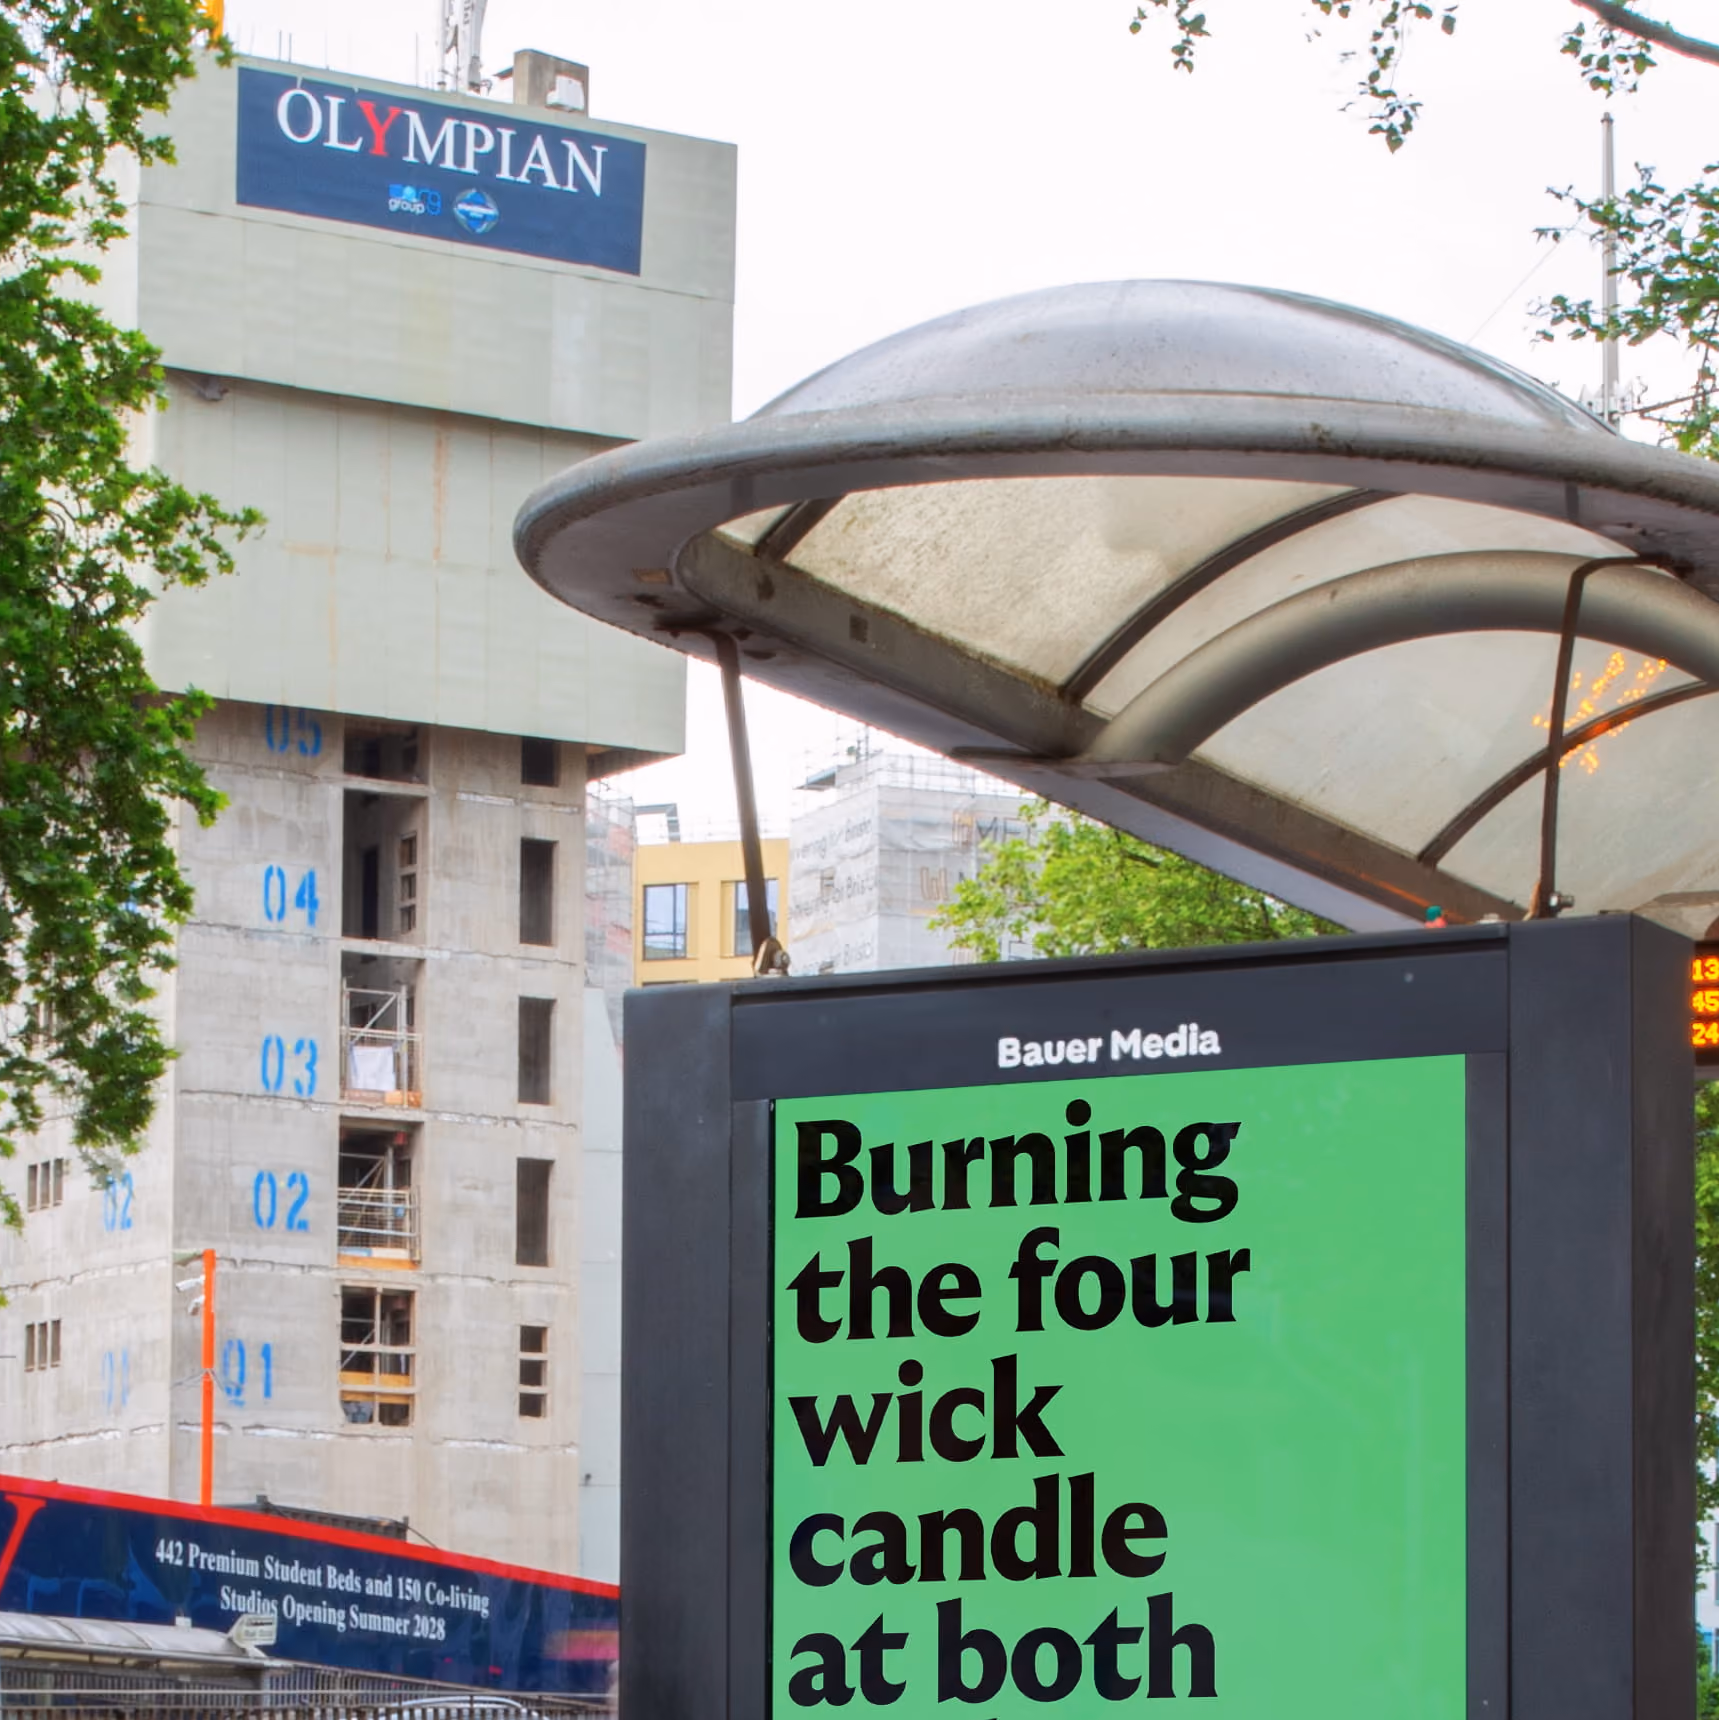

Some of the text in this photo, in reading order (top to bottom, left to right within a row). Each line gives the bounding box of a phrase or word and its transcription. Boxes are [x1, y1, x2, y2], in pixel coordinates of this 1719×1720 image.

[277, 88, 608, 197] OLYMPIAN
[265, 704, 322, 757] 05
[263, 865, 320, 927] 04
[261, 1034, 319, 1097] 03
[997, 1023, 1221, 1069] Bauer Media
[796, 1099, 1241, 1223] Burning
[104, 1171, 134, 1232] 02
[254, 1171, 311, 1232] 02
[787, 1227, 1250, 1343] the four
[789, 1354, 1065, 1466] wick
[790, 1472, 1168, 1586] candle
[155, 1537, 490, 1618] 442 Premium Student Beds and 150 Co-living
[220, 1584, 279, 1615] Studios
[282, 1594, 345, 1633] Opening
[349, 1604, 410, 1636] Summer
[413, 1614, 445, 1641] 2028
[789, 1592, 1217, 1706] at both
